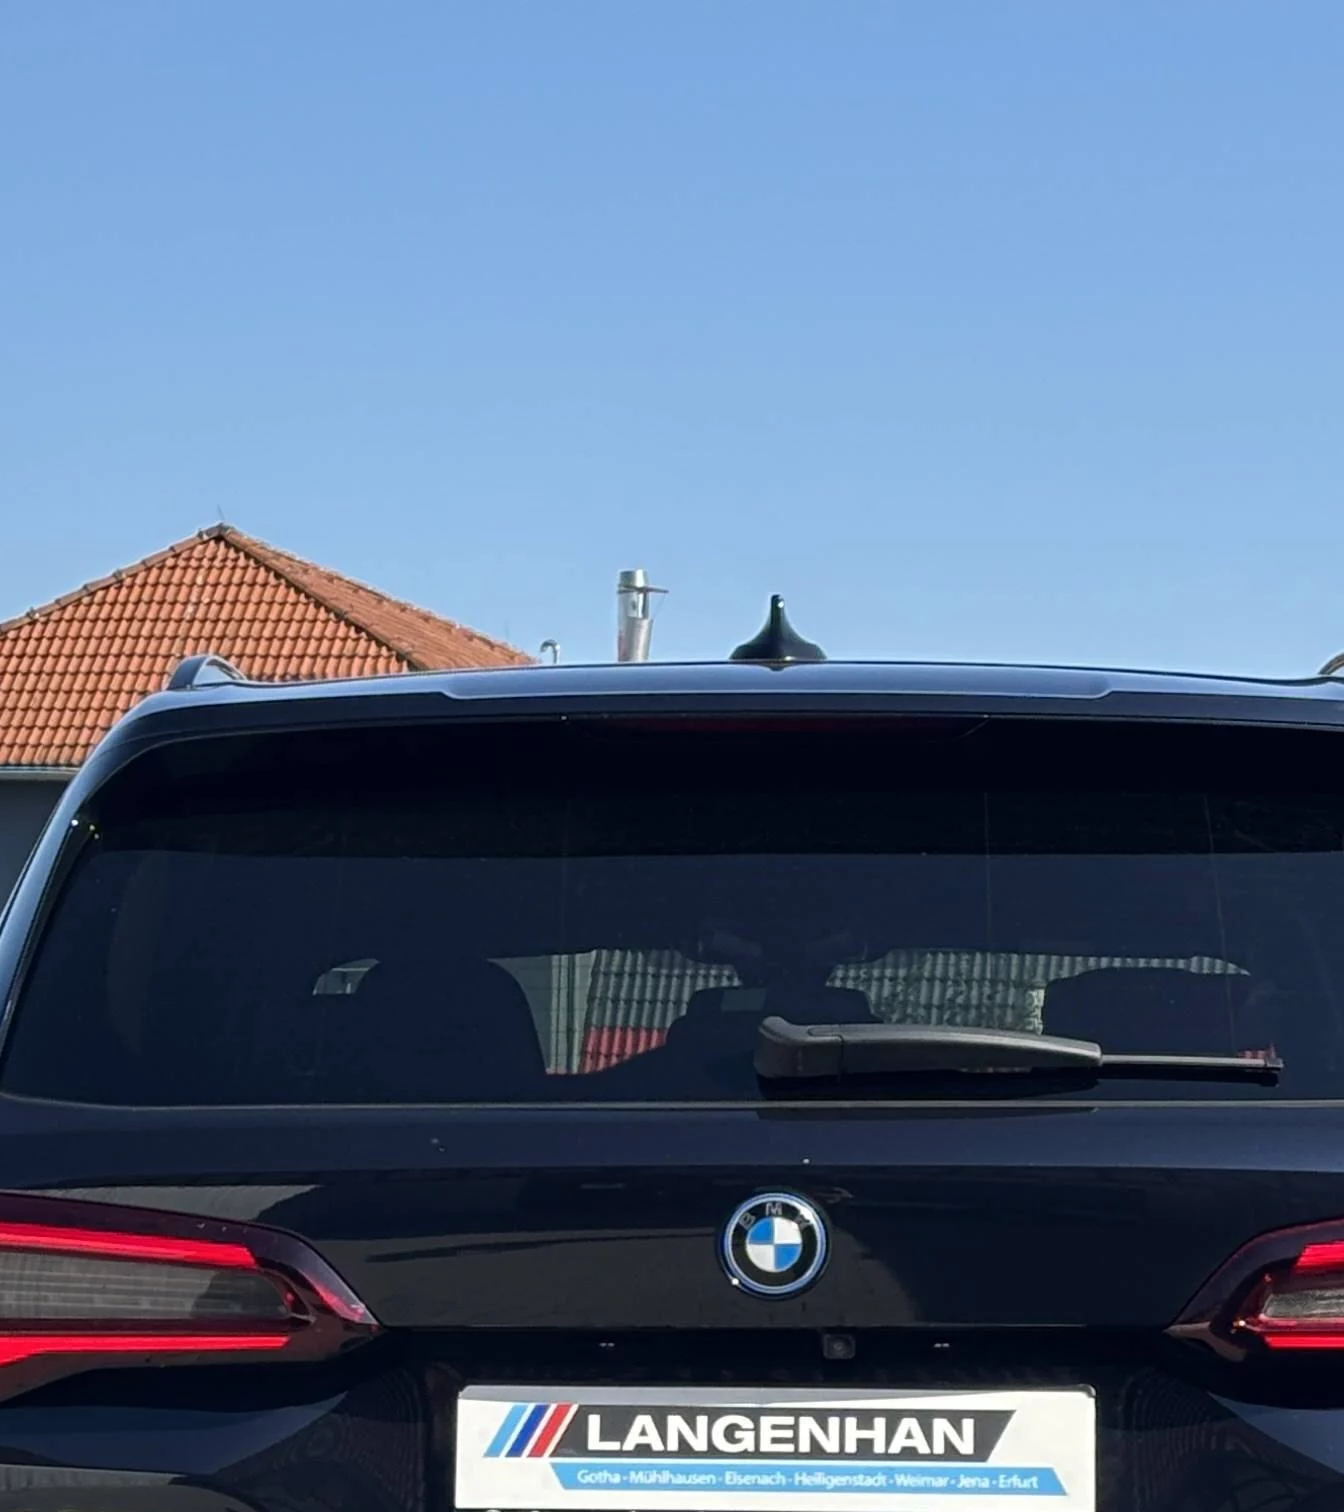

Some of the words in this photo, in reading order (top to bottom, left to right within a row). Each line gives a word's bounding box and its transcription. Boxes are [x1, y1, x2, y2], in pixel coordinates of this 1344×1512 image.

[586, 1414, 975, 1456] LANGENHAN
[576, 1469, 621, 1485] Gotha
[628, 1470, 717, 1486] Mühlhausen
[724, 1471, 786, 1486] Eisenach
[793, 1471, 887, 1490] Heiligenstadt
[894, 1473, 949, 1488] Weimar
[956, 1474, 990, 1489] Jena
[998, 1474, 1039, 1489] Erfurt
